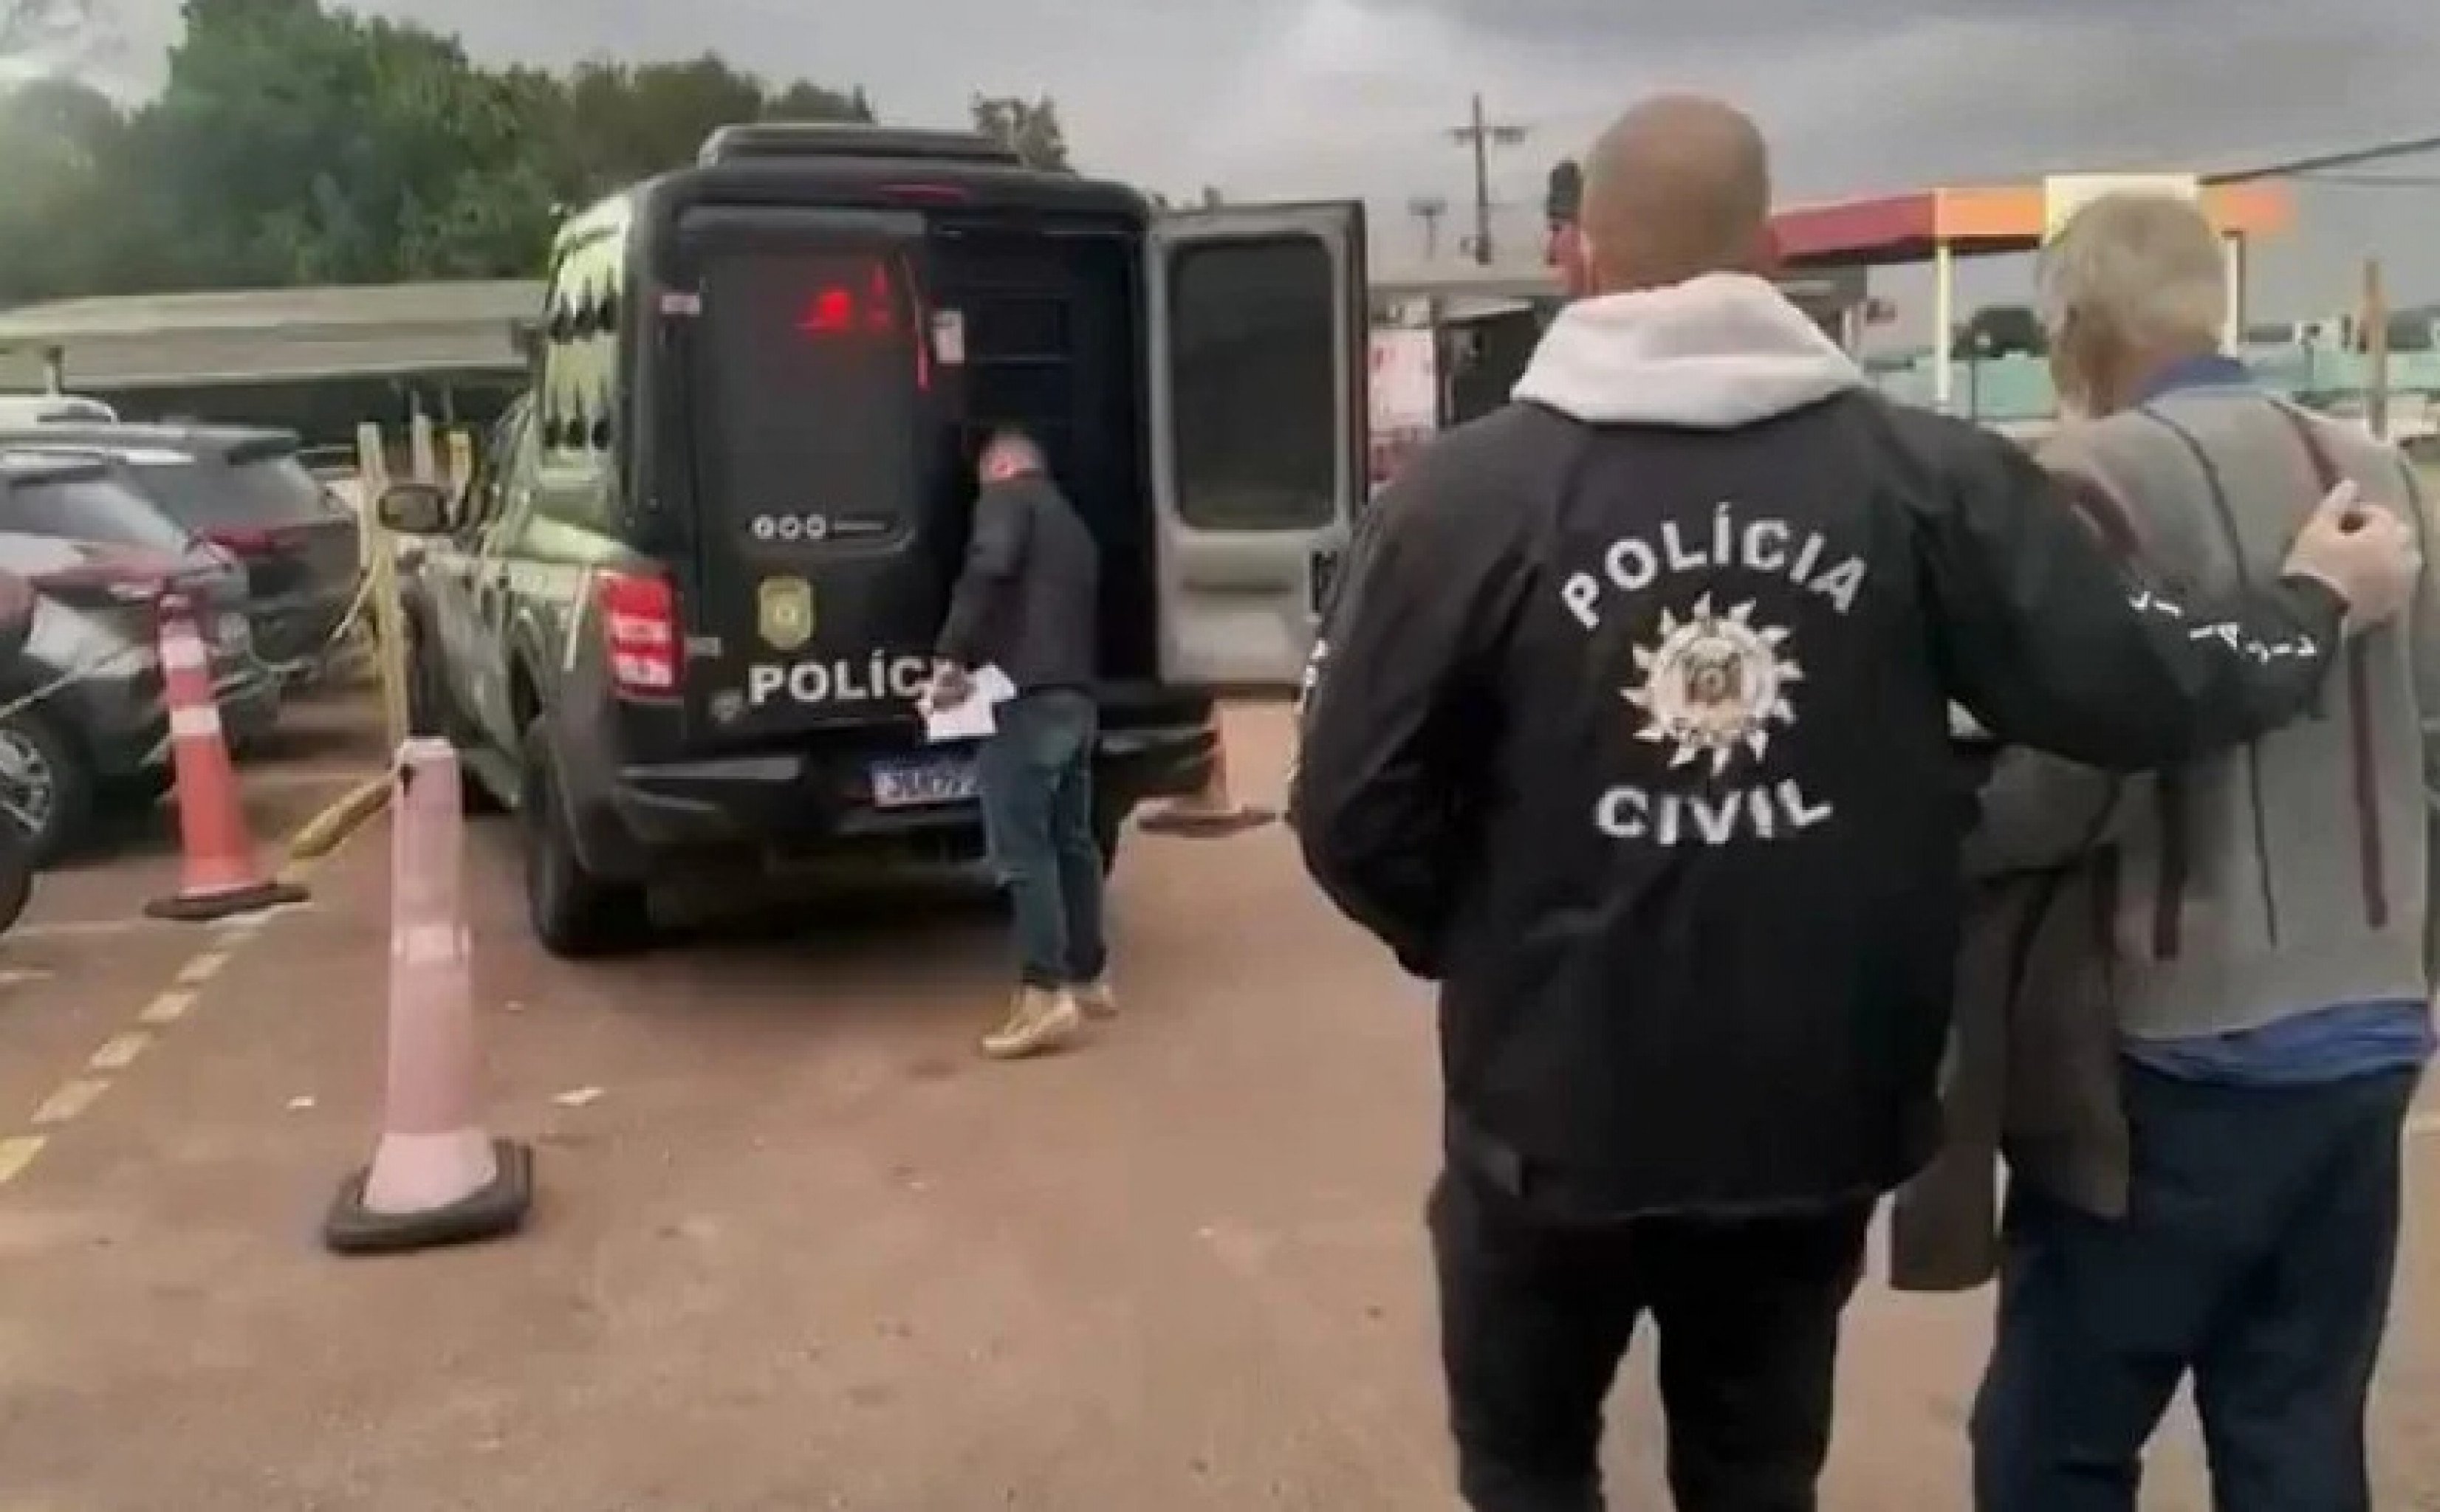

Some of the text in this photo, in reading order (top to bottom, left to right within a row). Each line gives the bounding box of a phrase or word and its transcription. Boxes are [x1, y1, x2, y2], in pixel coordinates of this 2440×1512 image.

[1561, 502, 1866, 630] POLÍCIA
[749, 648, 942, 705] POLÍC
[1594, 779, 1833, 845] CIVIL
